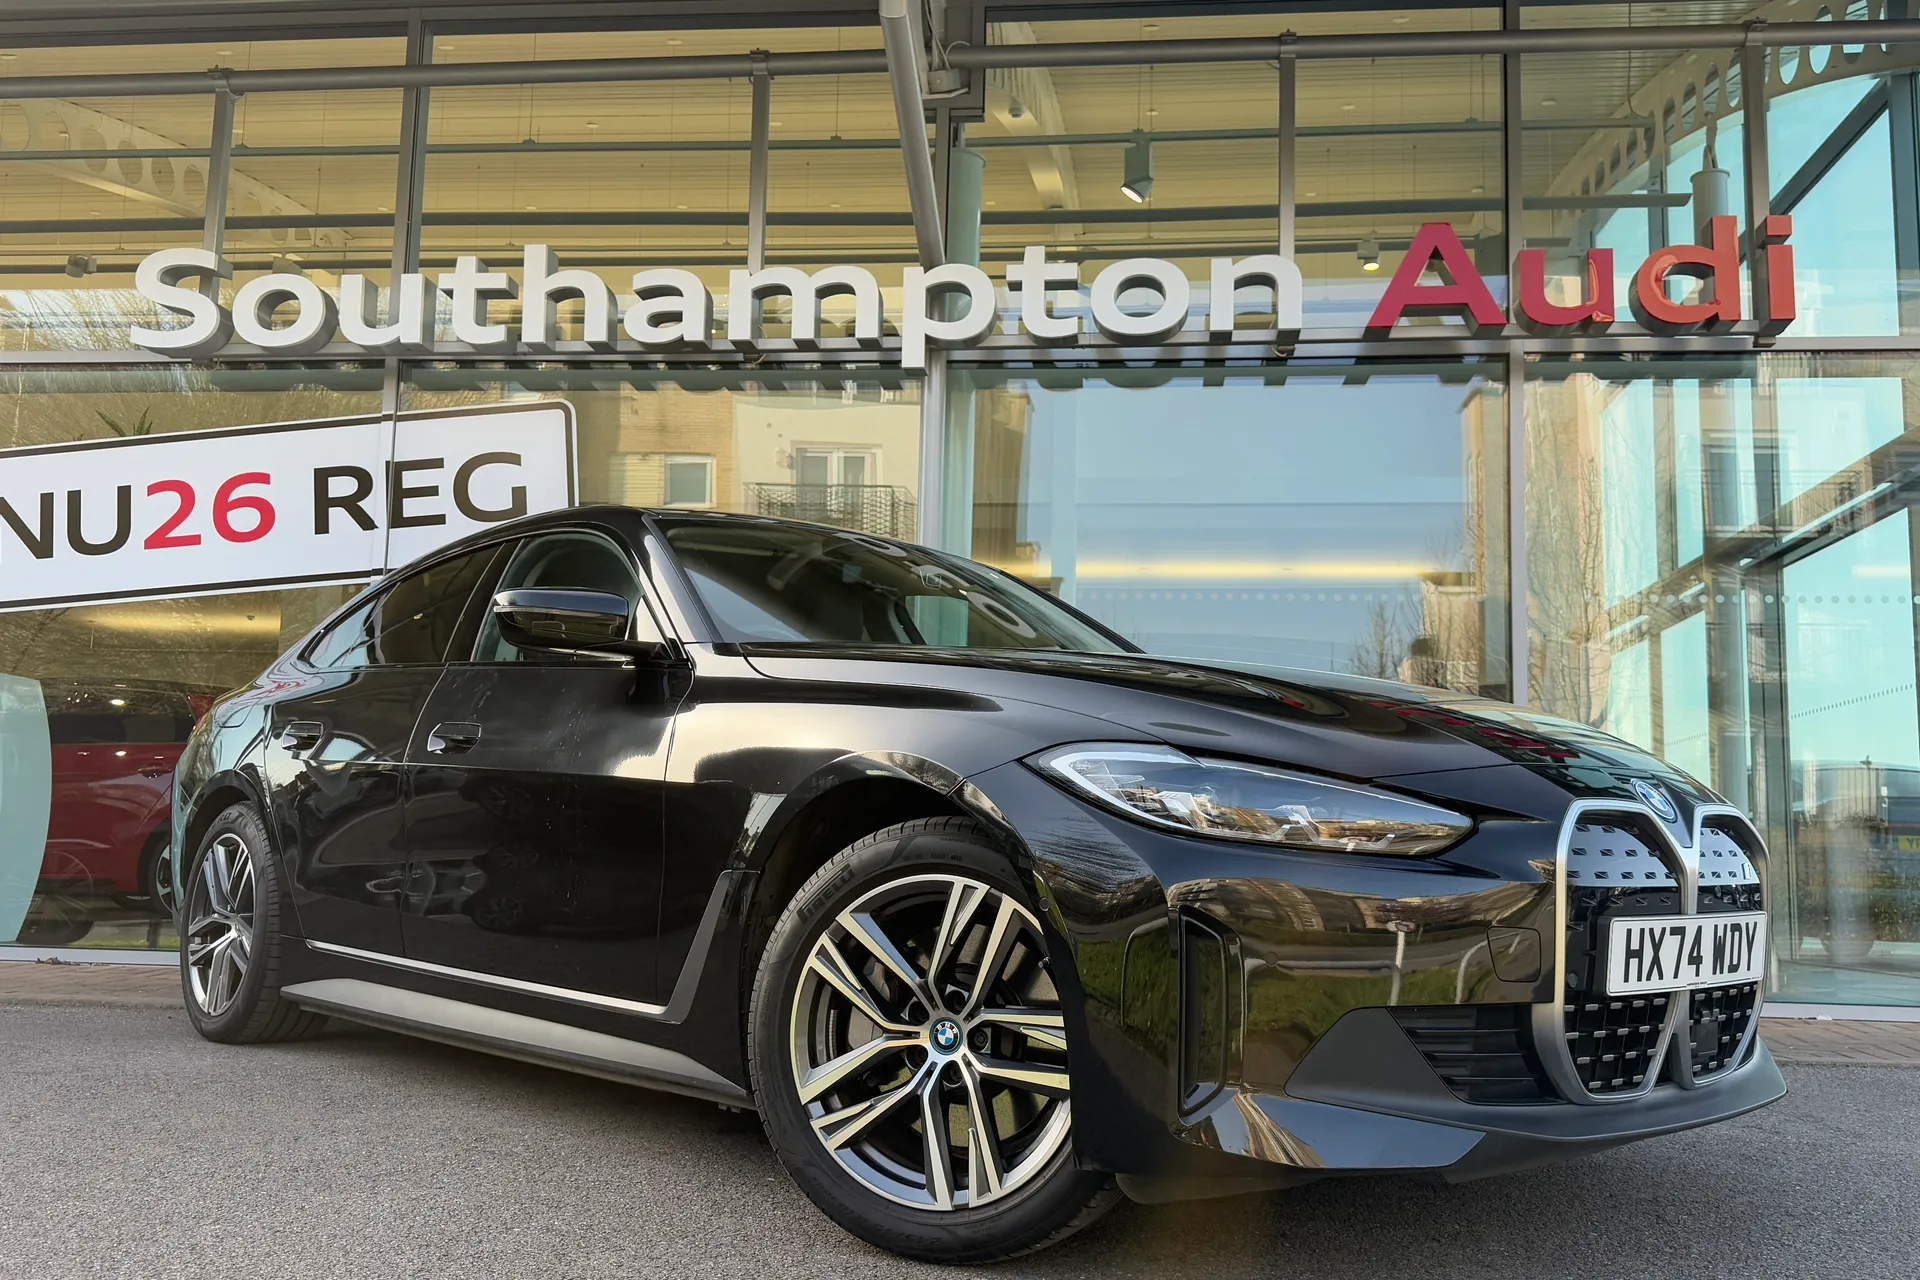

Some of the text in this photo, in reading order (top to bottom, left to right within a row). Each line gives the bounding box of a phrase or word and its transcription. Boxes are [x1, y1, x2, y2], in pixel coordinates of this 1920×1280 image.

[130, 215, 1796, 373] Southampton Audi
[0, 452, 528, 560] NU26 REG
[796, 863, 856, 924] PIRELLI
[1623, 922, 1758, 984] HX74 WDY
